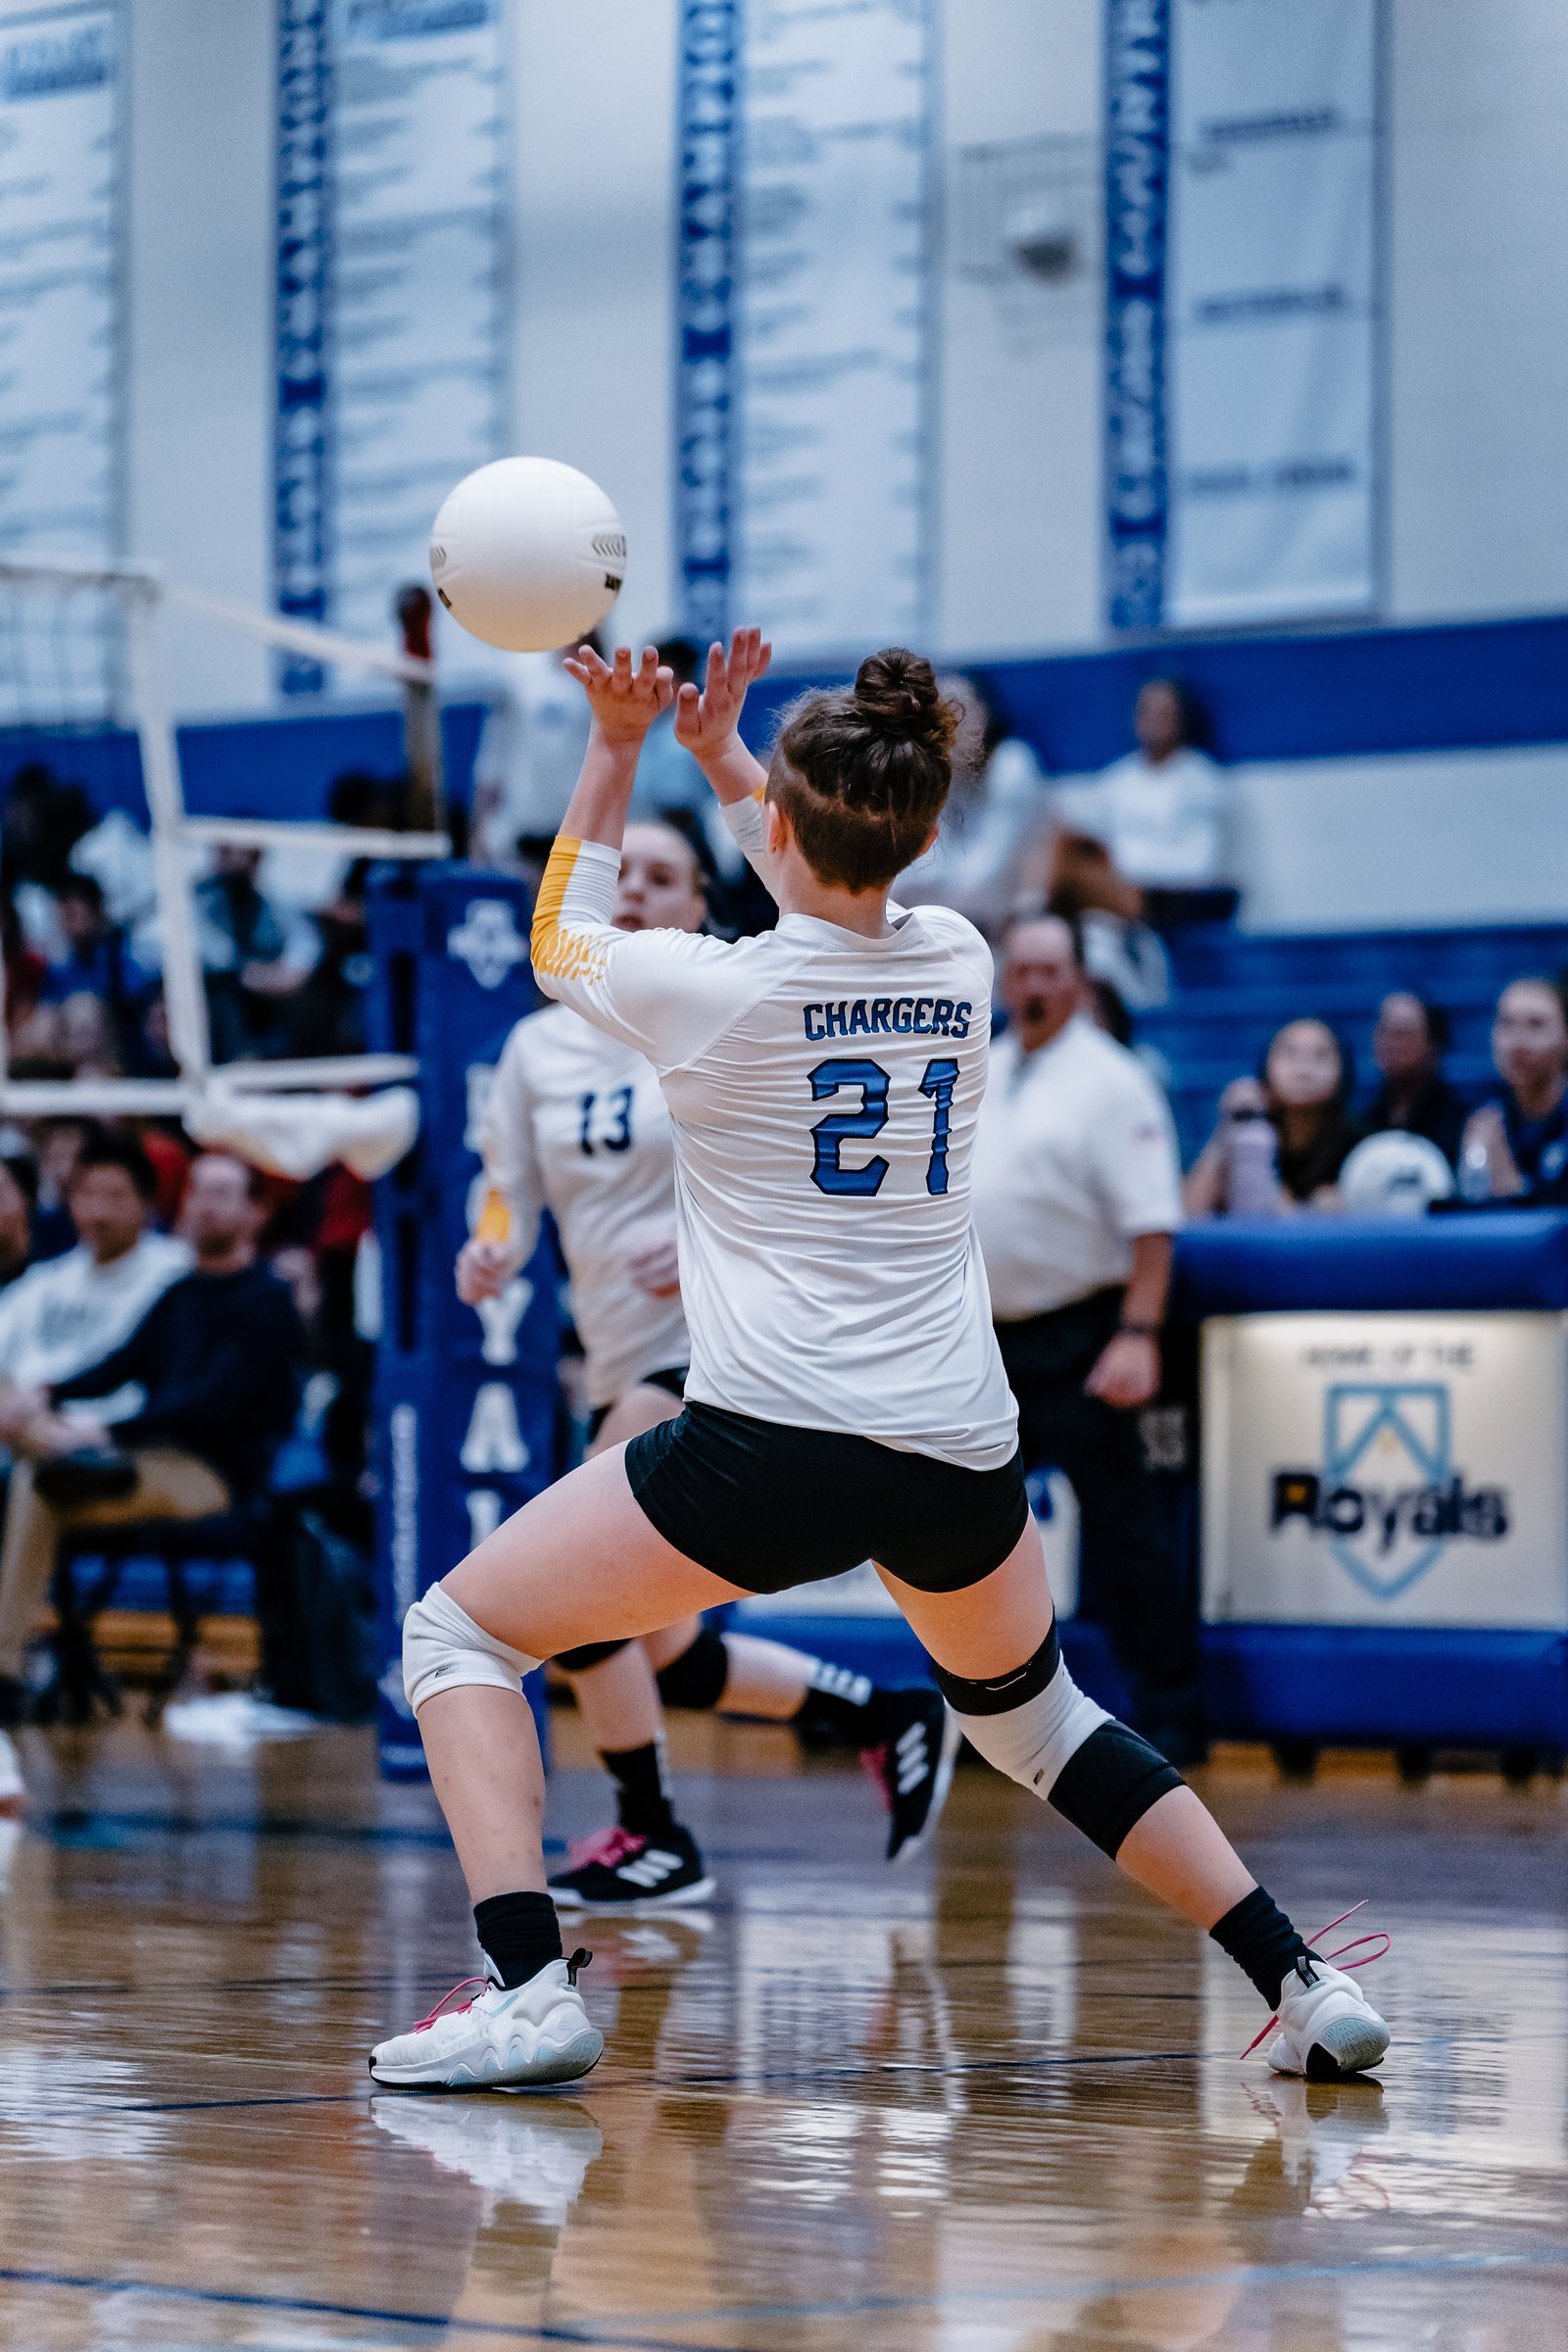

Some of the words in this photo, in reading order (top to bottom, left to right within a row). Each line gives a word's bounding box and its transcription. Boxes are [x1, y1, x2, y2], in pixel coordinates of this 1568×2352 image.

[803, 998, 972, 1041] CHARGERS
[578, 1086, 633, 1156] 13
[807, 1058, 960, 1197] 21
[1268, 1471, 1509, 1554] Royals
